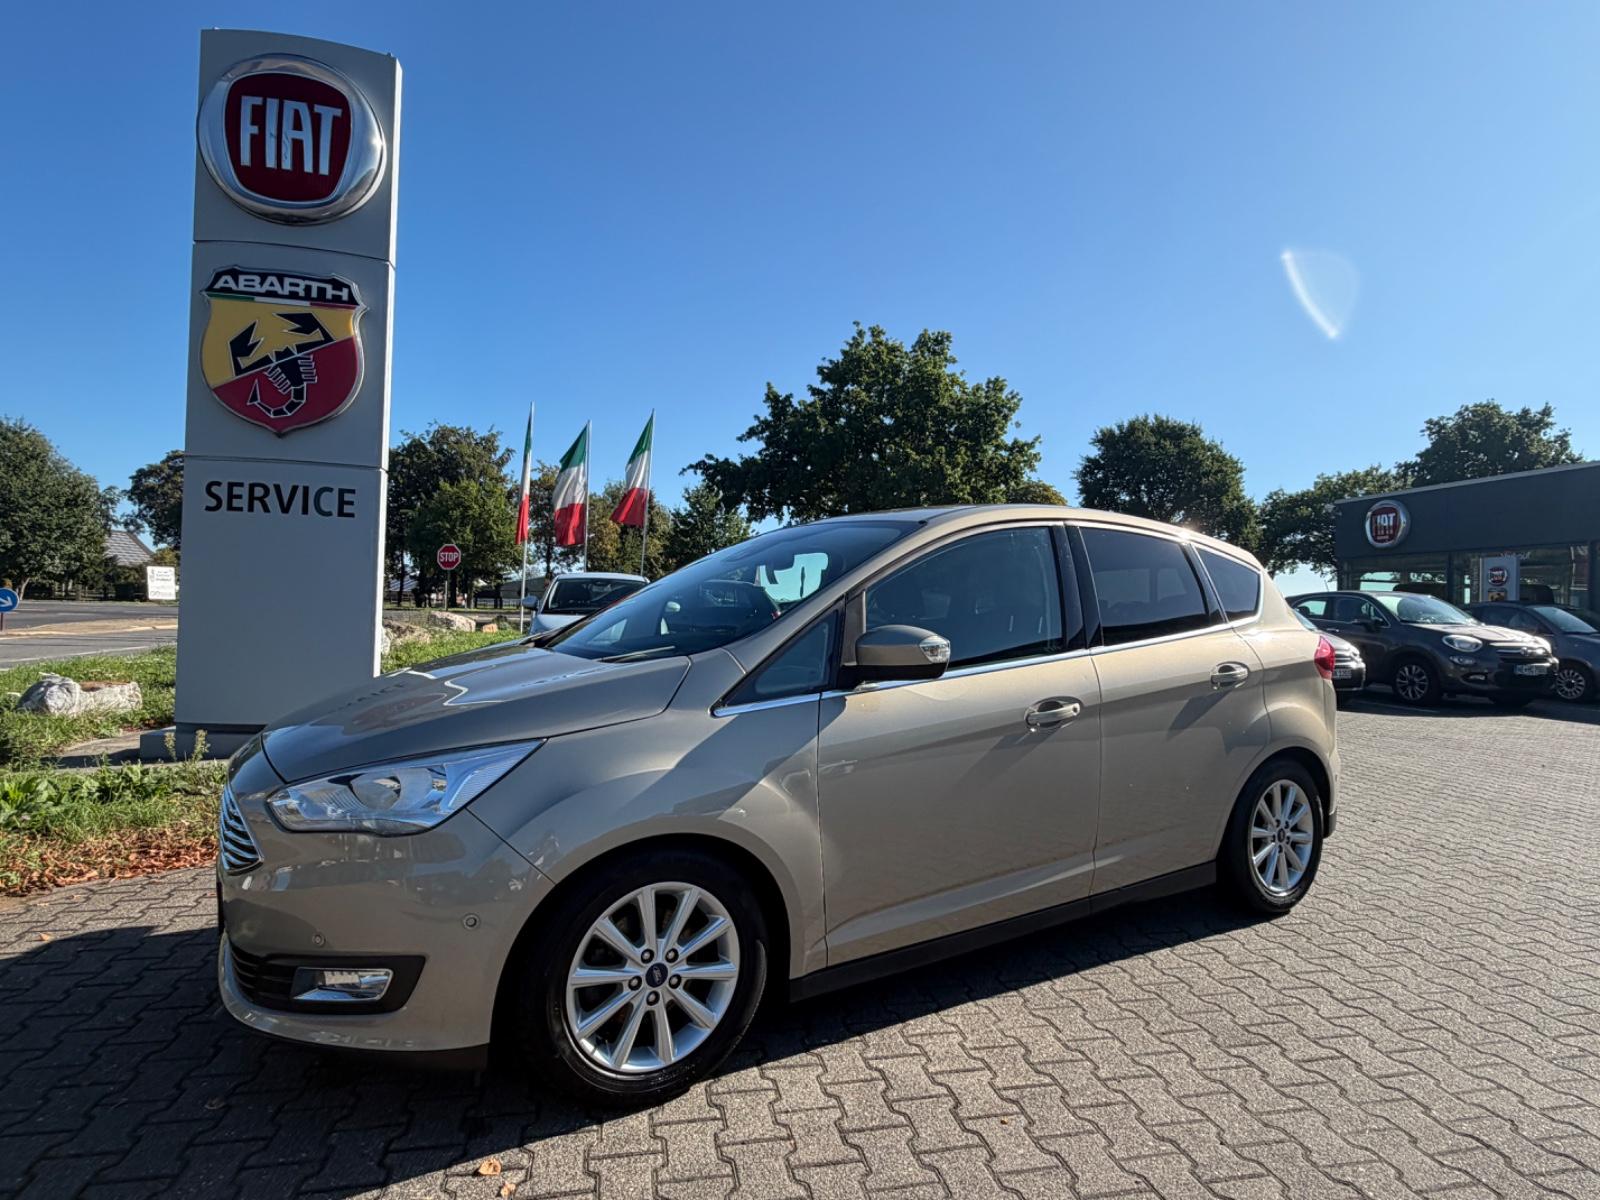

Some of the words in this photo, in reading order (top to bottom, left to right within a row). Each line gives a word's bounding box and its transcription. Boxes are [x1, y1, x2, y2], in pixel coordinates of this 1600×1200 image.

[240, 95, 343, 176] FIAT
[213, 274, 349, 301] ABARTH
[204, 480, 356, 518] SERVICE
[440, 552, 459, 562] STOP
